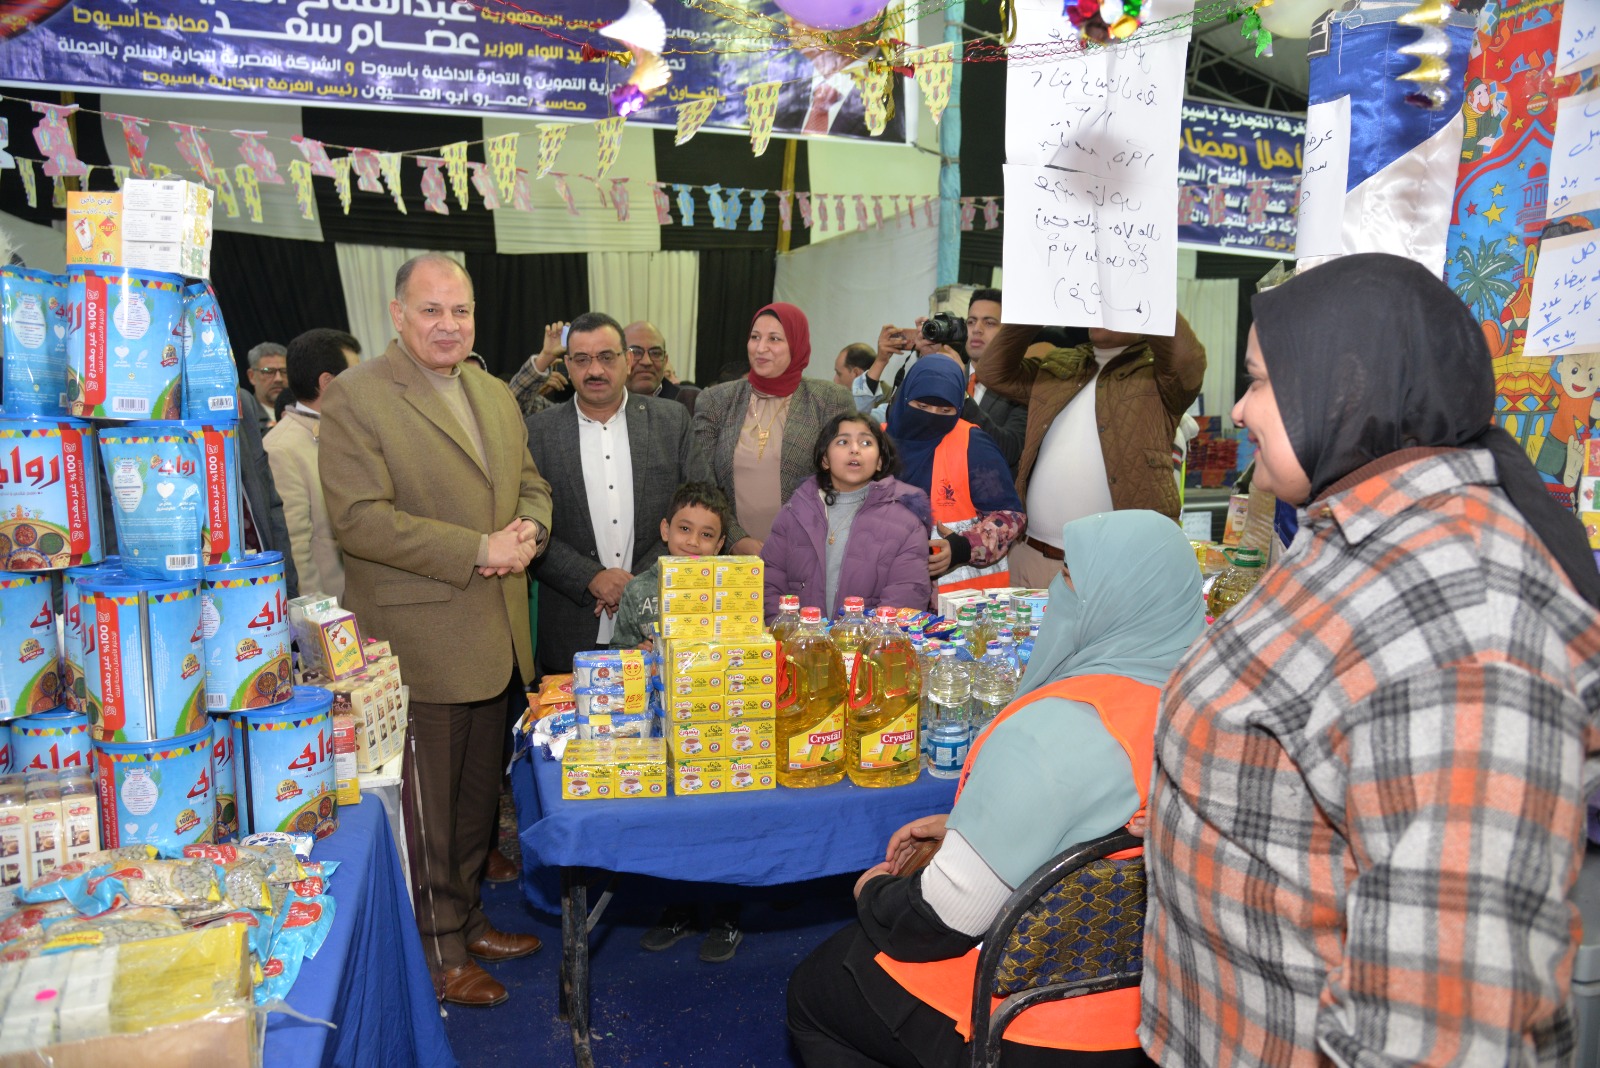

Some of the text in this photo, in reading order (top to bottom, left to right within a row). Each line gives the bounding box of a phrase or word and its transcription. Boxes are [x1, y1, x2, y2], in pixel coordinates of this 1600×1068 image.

[73, 6, 141, 30] أسيوط
[143, 12, 209, 33] محافظ
[213, 10, 342, 43] سعد
[348, 20, 481, 56] عصام
[58, 37, 118, 60] بالجملة
[123, 44, 167, 63] السلع
[171, 47, 216, 65] لتجارة
[484, 41, 523, 57] الوزير
[527, 44, 564, 59] اللواء
[220, 51, 281, 71] المصرية
[285, 55, 341, 72] الشركة
[344, 61, 355, 76] و
[421, 65, 473, 81] الداخلية
[477, 69, 520, 86] التجارة
[208, 75, 263, 90] التجارية
[267, 79, 313, 92] الغرفة
[523, 76, 533, 87] و
[535, 78, 586, 93] التموين
[316, 83, 358, 98] رئيس
[536, 100, 587, 111] محاسب
[1181, 104, 1218, 126] بأسيو
[1221, 107, 1274, 130] التجارية
[1179, 127, 1248, 166] رمضا
[730, 725, 750, 734] ينسون
[810, 730, 841, 744] Crystal
[882, 730, 914, 744] Crystal
[680, 765, 701, 773] Anise
[731, 763, 752, 771] Anise
